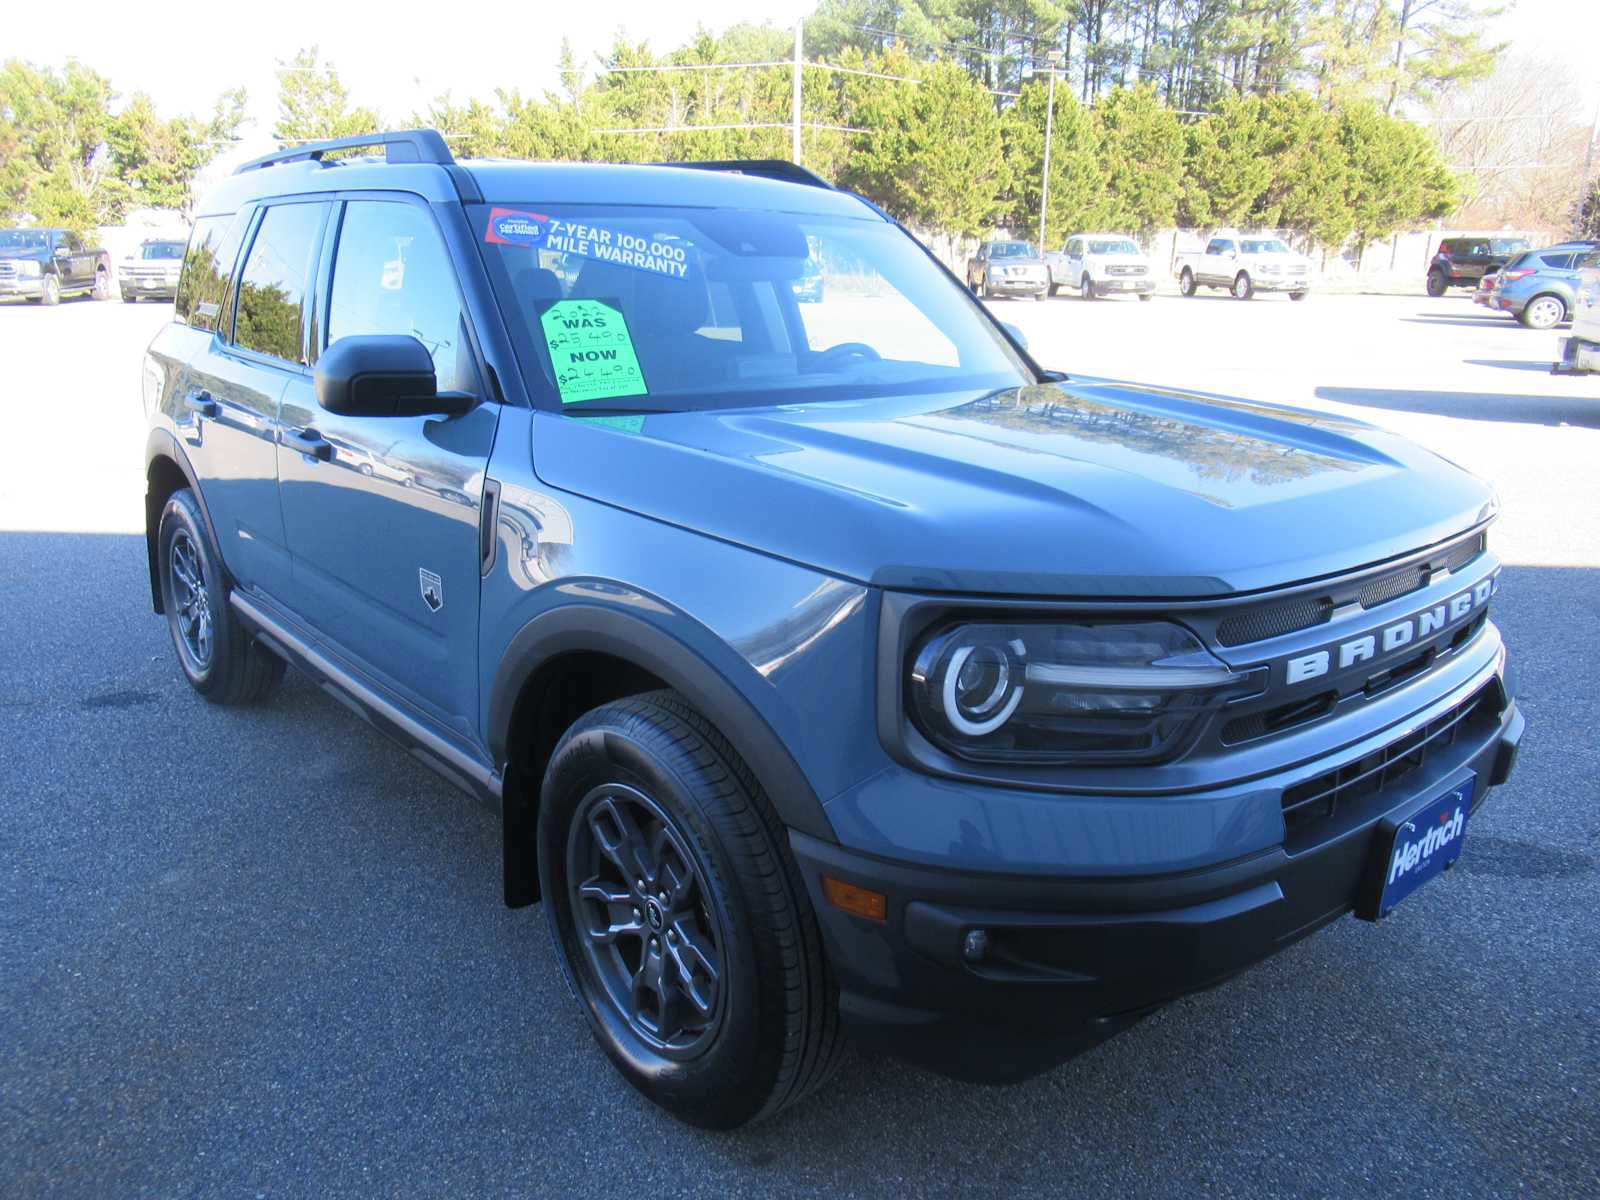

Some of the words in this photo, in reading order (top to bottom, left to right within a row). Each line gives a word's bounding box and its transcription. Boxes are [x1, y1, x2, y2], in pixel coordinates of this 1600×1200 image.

[547, 234, 590, 255] MILE
[594, 243, 688, 277] WARRANTY
[549, 219, 611, 244] 7-YEAR
[617, 233, 686, 262] 100,000
[562, 318, 607, 329] WAS
[570, 349, 617, 363] NOW
[1286, 579, 1492, 685] BRONCO
[1388, 806, 1464, 885] Hertrich
